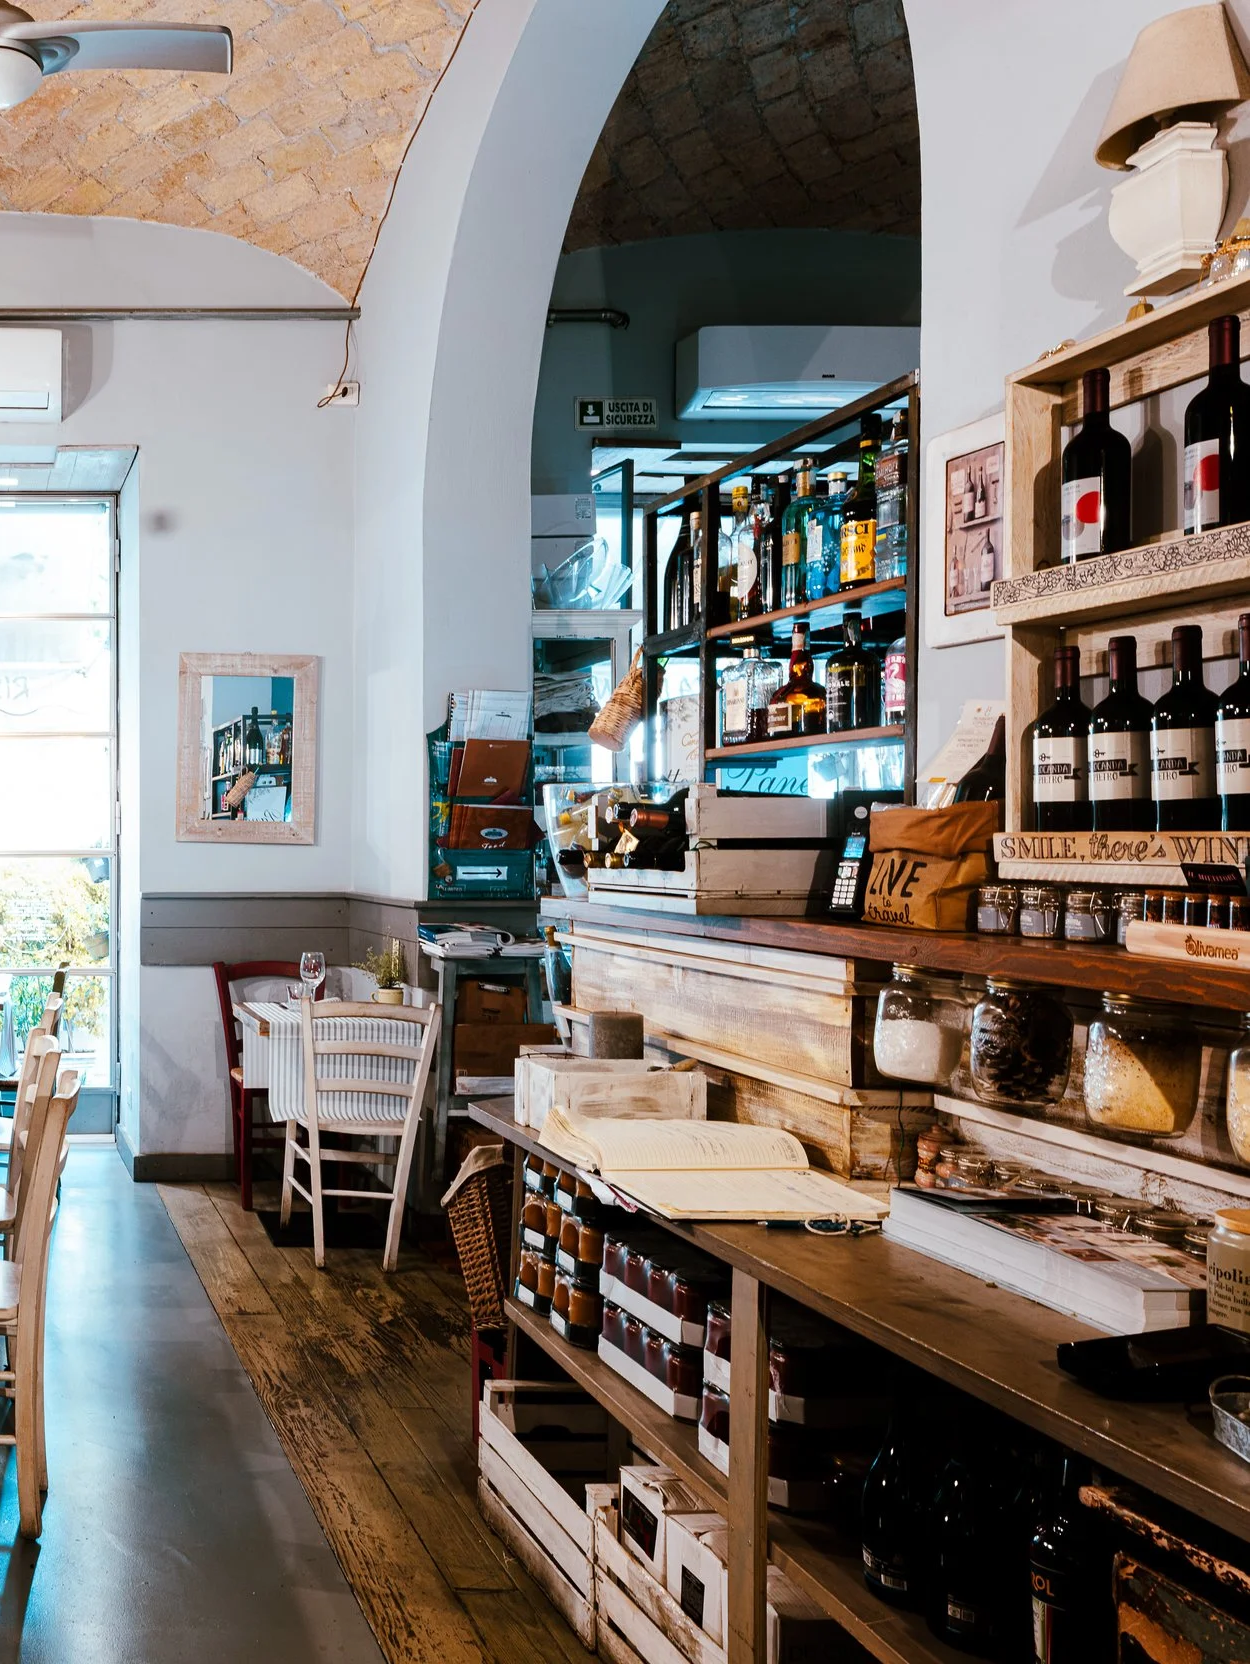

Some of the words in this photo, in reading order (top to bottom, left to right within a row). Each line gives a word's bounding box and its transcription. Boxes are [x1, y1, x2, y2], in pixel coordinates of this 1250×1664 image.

[608, 402, 640, 413] USCITA
[643, 402, 652, 412] DI
[606, 414, 655, 425] SICUREZZA
[841, 523, 869, 538] RSCI
[1037, 764, 1068, 774] OCANDA
[1093, 760, 1123, 771] OCANDA
[1156, 759, 1183, 769] CANDA
[1095, 772, 1118, 781] IETRO
[1158, 771, 1178, 781] ETRO
[1089, 832, 1166, 862] there's
[869, 858, 927, 898] LIVE
[882, 895, 892, 907] to
[868, 903, 914, 925] travel
[1185, 933, 1239, 961] Olivamea
